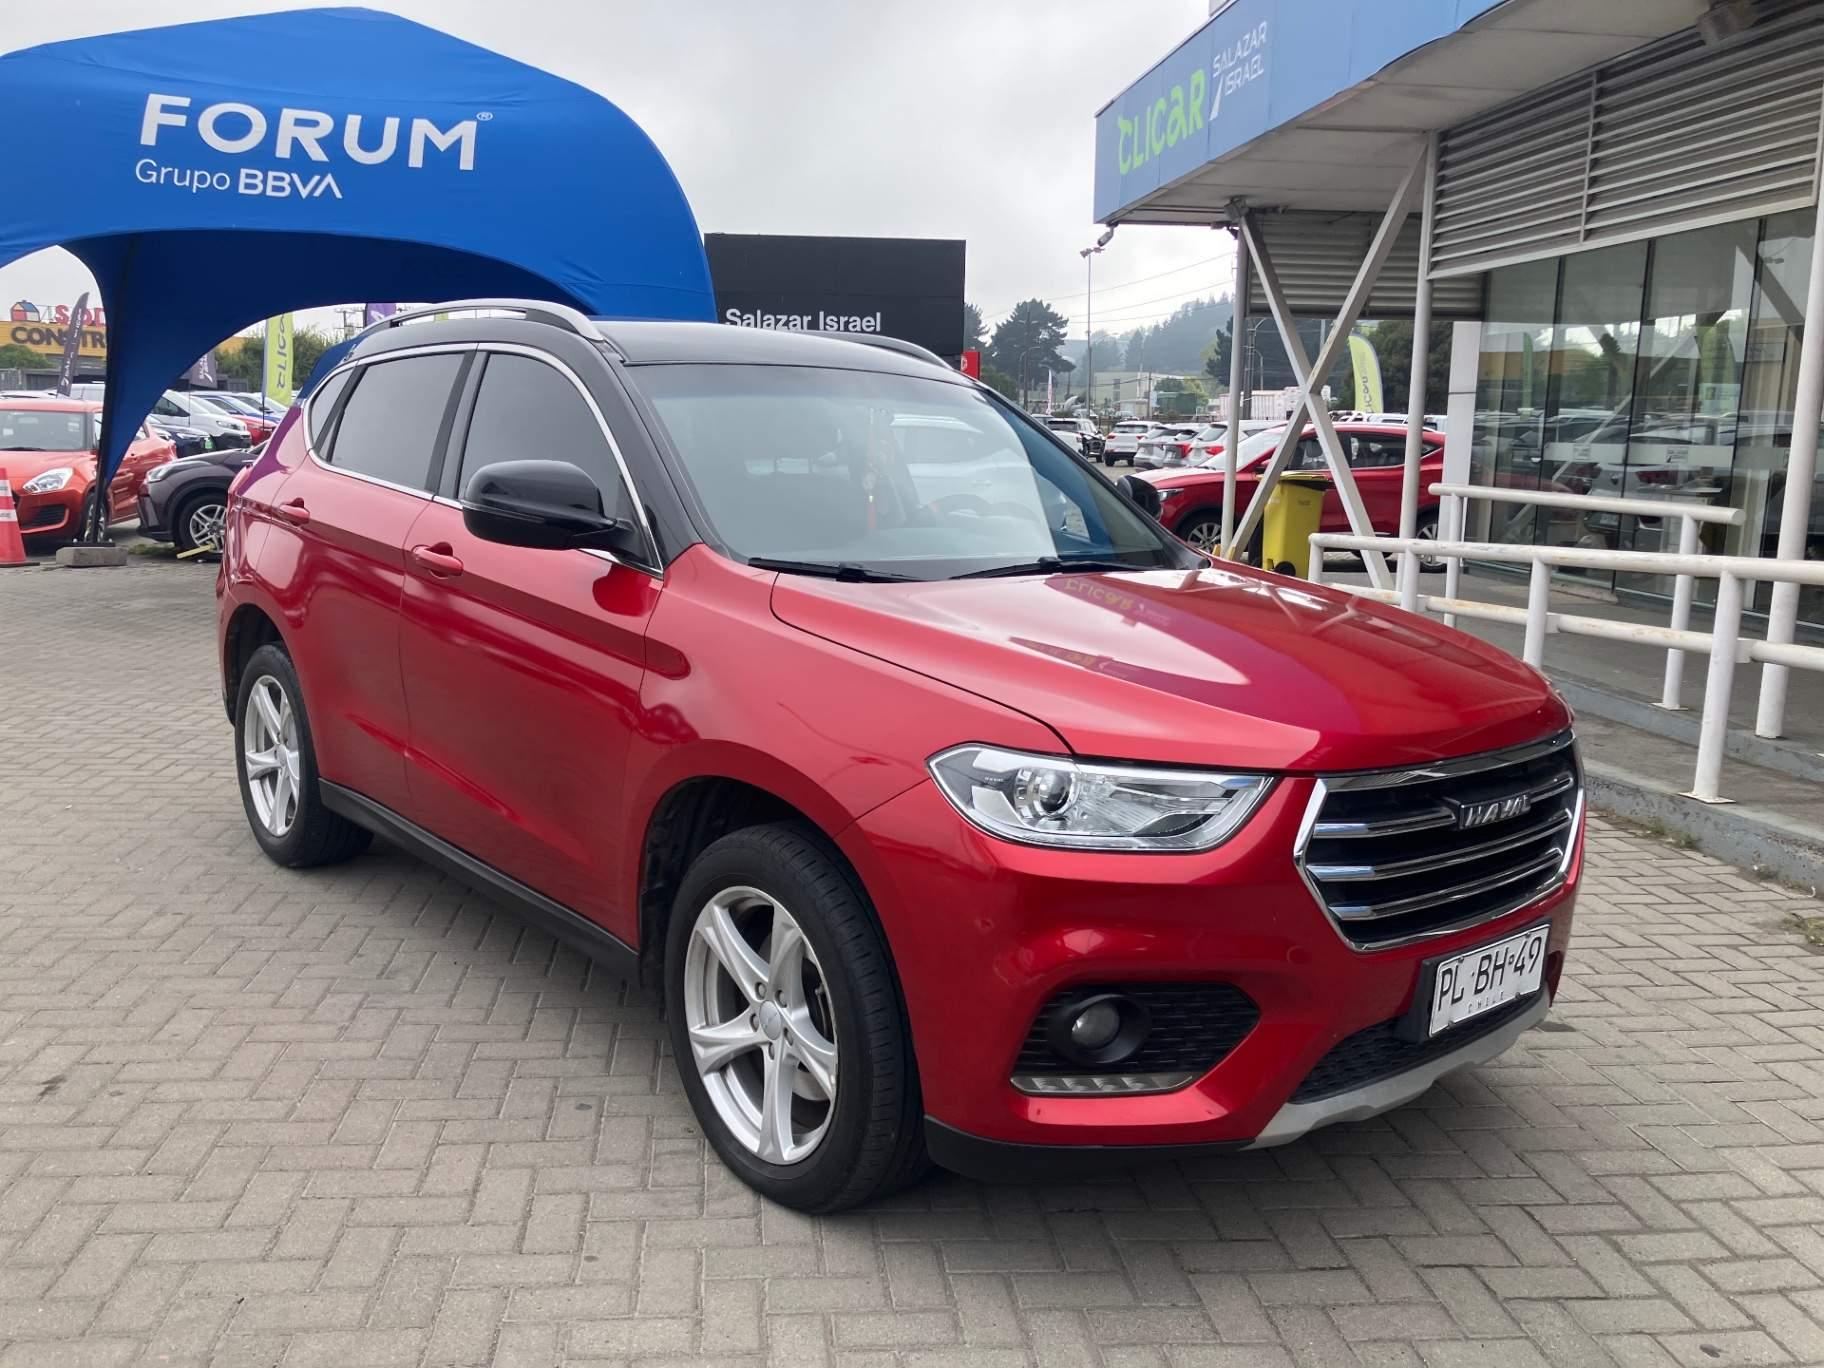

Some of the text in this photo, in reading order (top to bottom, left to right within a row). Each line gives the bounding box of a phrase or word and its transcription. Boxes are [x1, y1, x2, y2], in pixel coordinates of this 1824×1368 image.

[1213, 21, 1267, 78] SALAZAR
[1225, 54, 1264, 96] ISRAEL
[135, 158, 343, 199] Grupo BBVA
[726, 309, 881, 332] Salazar Israel
